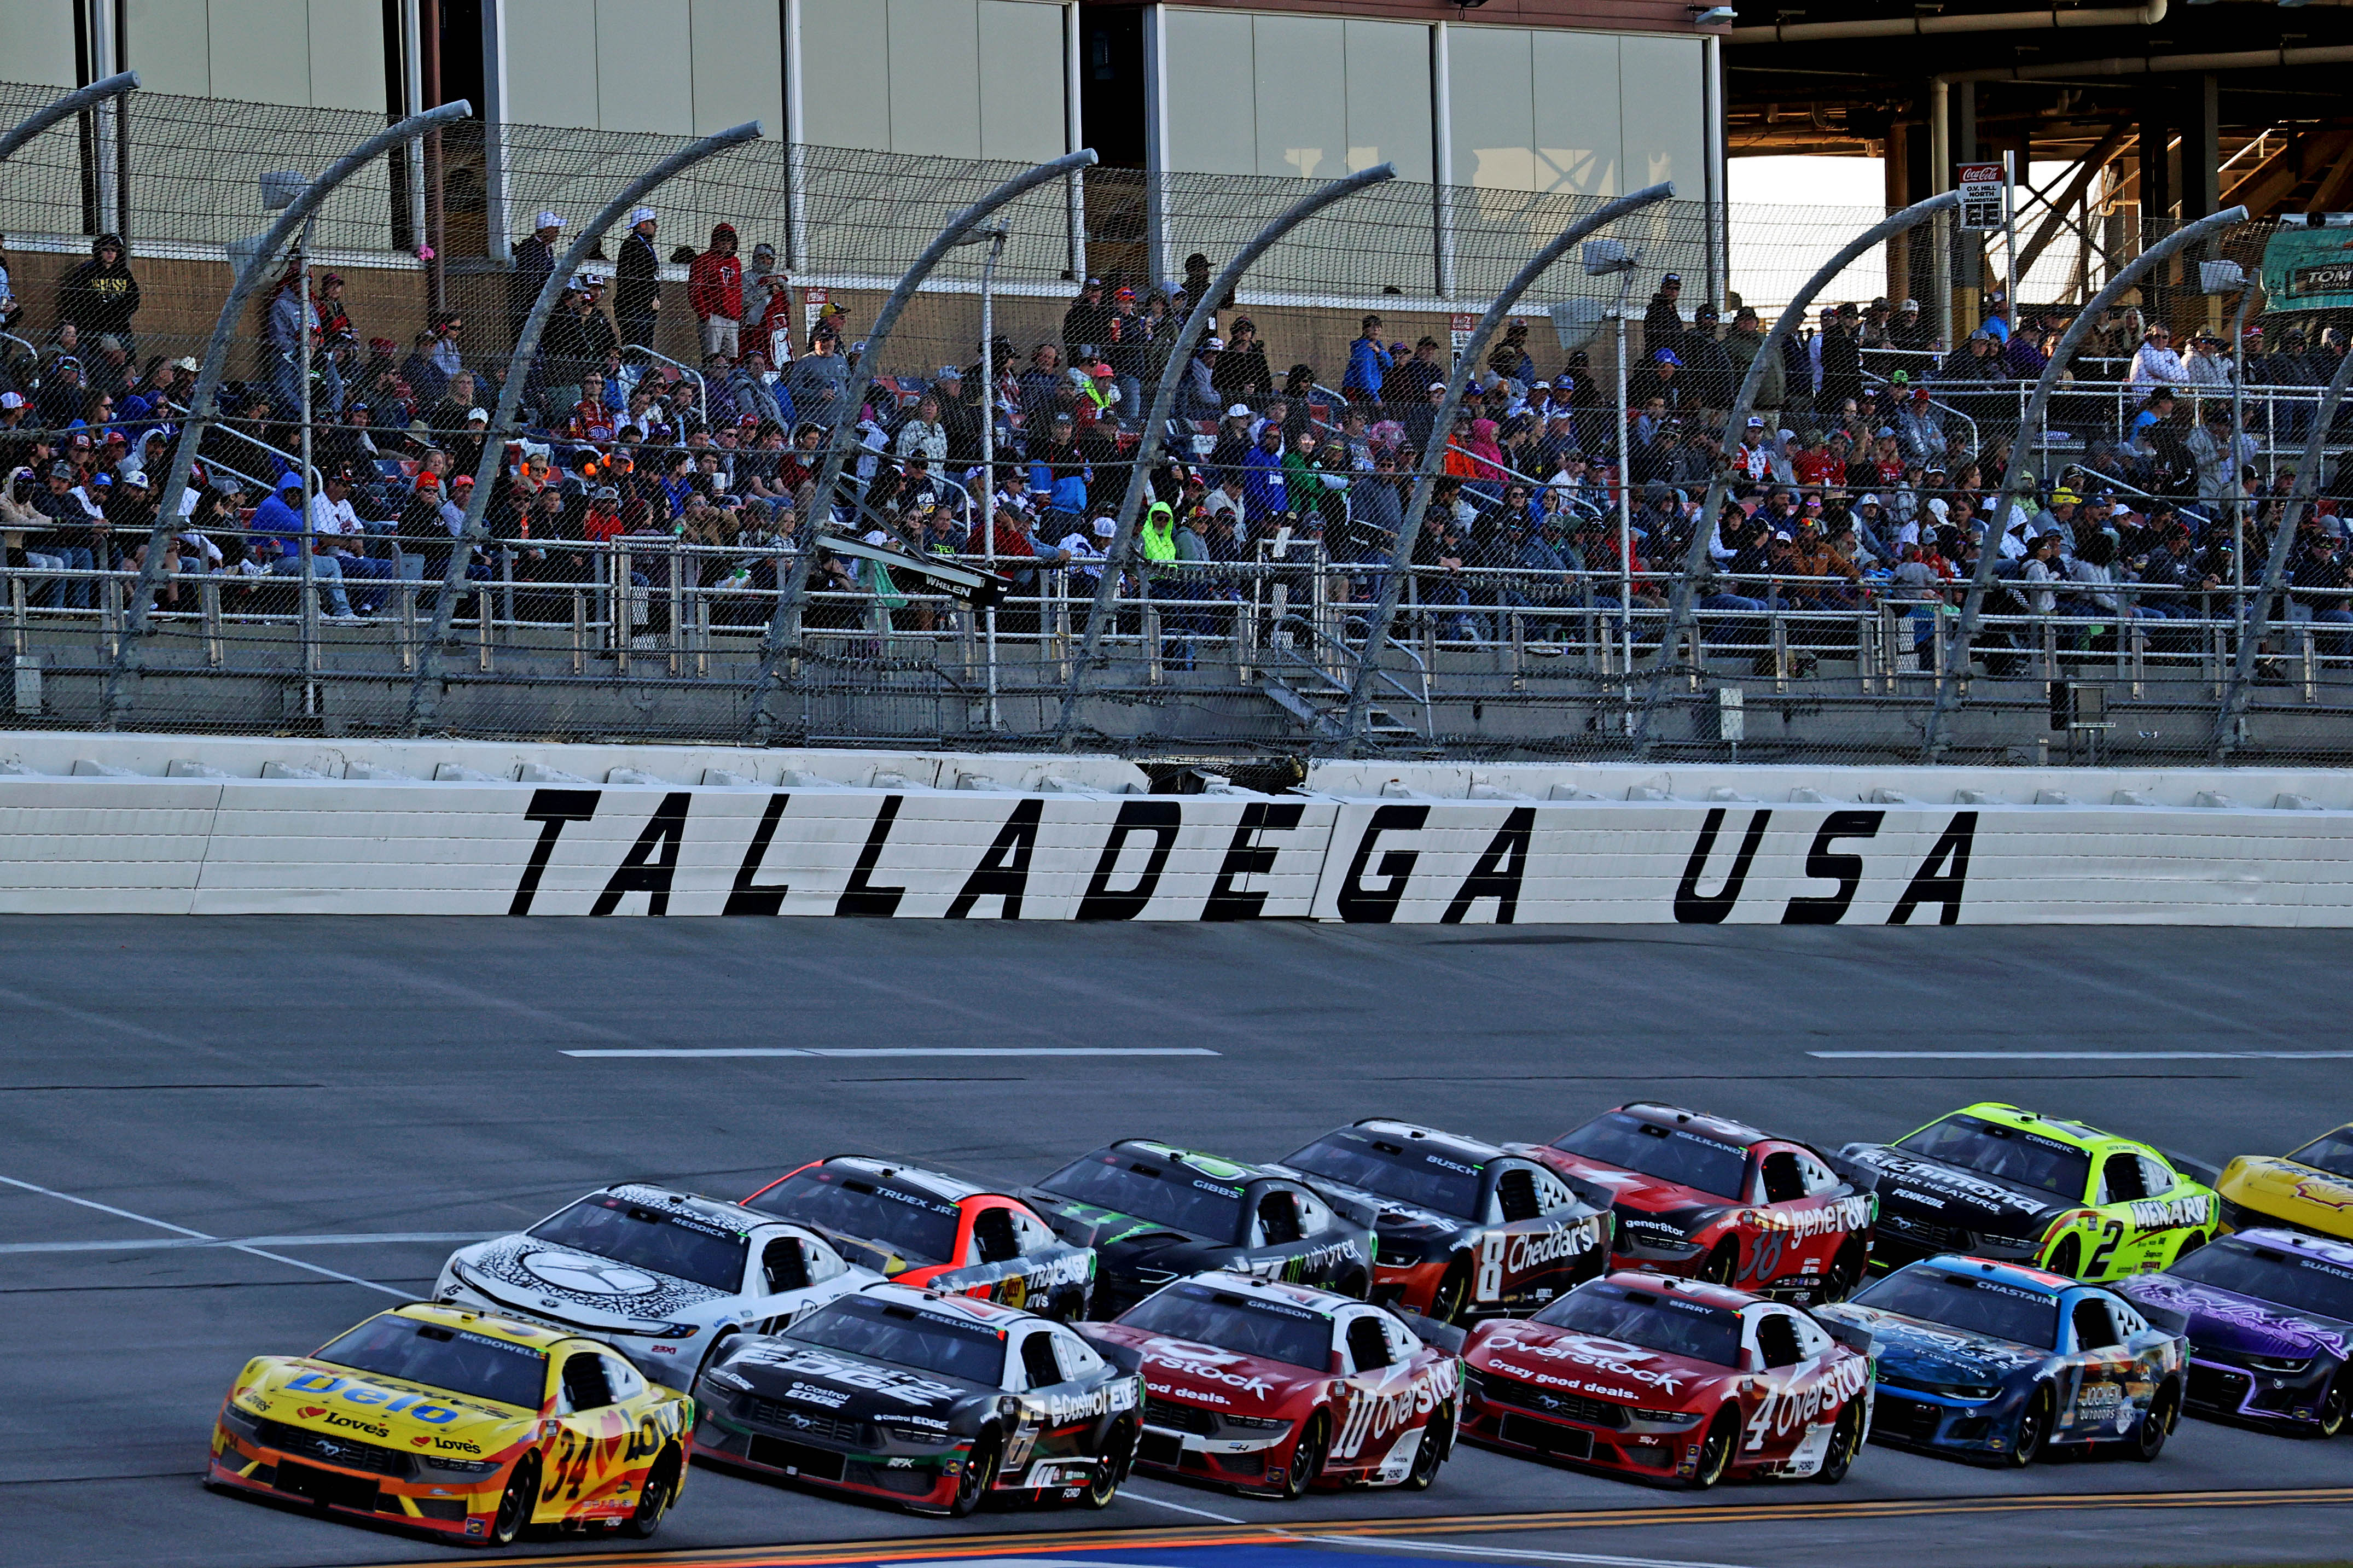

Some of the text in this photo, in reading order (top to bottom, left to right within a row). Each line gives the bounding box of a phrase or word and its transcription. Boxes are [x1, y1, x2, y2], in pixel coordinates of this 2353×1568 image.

[926, 575, 972, 597] WHELEN
[509, 789, 1978, 924] TALLADEGA USA
[1676, 1131, 1741, 1155] GILLILAND
[2025, 1134, 2075, 1154] CINDRIC
[1426, 1155, 1478, 1176] BUSCH
[1193, 1180, 1240, 1199] GIBBS
[1852, 1152, 2050, 1215] Richmond
[1880, 1170, 2001, 1211] ATER HEATERS
[876, 1186, 928, 1208] TRUEX
[1891, 1188, 1946, 1209] PENNZOIL
[671, 1216, 727, 1239] REDDICK
[1625, 1219, 1685, 1237] gener8tor
[1508, 1216, 1594, 1274] Cheddar's
[1738, 1211, 1790, 1282] 38
[2082, 1218, 2124, 1279] 2
[1026, 1254, 1089, 1291] TRACKER
[1476, 1230, 1507, 1302] 8
[442, 1284, 463, 1297] 45
[1024, 1292, 1049, 1310] ATVs
[1977, 1281, 2057, 1307] CHASTAIN
[1247, 1301, 1312, 1320] GRAGSON
[1669, 1299, 1714, 1314] BERRY
[919, 1311, 998, 1336] KESELOWSK
[1139, 1352, 1274, 1401] rstock
[1483, 1335, 1684, 1396] Overstock
[1928, 1353, 1953, 1364] LUKE
[1954, 1361, 1987, 1379] BRYAN
[1488, 1359, 1640, 1400] Crazy good deals.
[284, 1372, 458, 1424] Delo
[785, 1389, 848, 1408] EDGE
[805, 1384, 851, 1401] Castrol
[1062, 1386, 1107, 1423] Castrol
[1146, 1382, 1231, 1405] od deals.
[882, 1414, 949, 1430] Castrol EDGE
[1329, 1388, 1378, 1459] 10
[1745, 1383, 1779, 1450] 4
[1000, 1400, 1045, 1473] 6
[542, 1426, 594, 1503] 34
[887, 1458, 915, 1468] RFK
[1062, 1488, 1081, 1499] FORD
